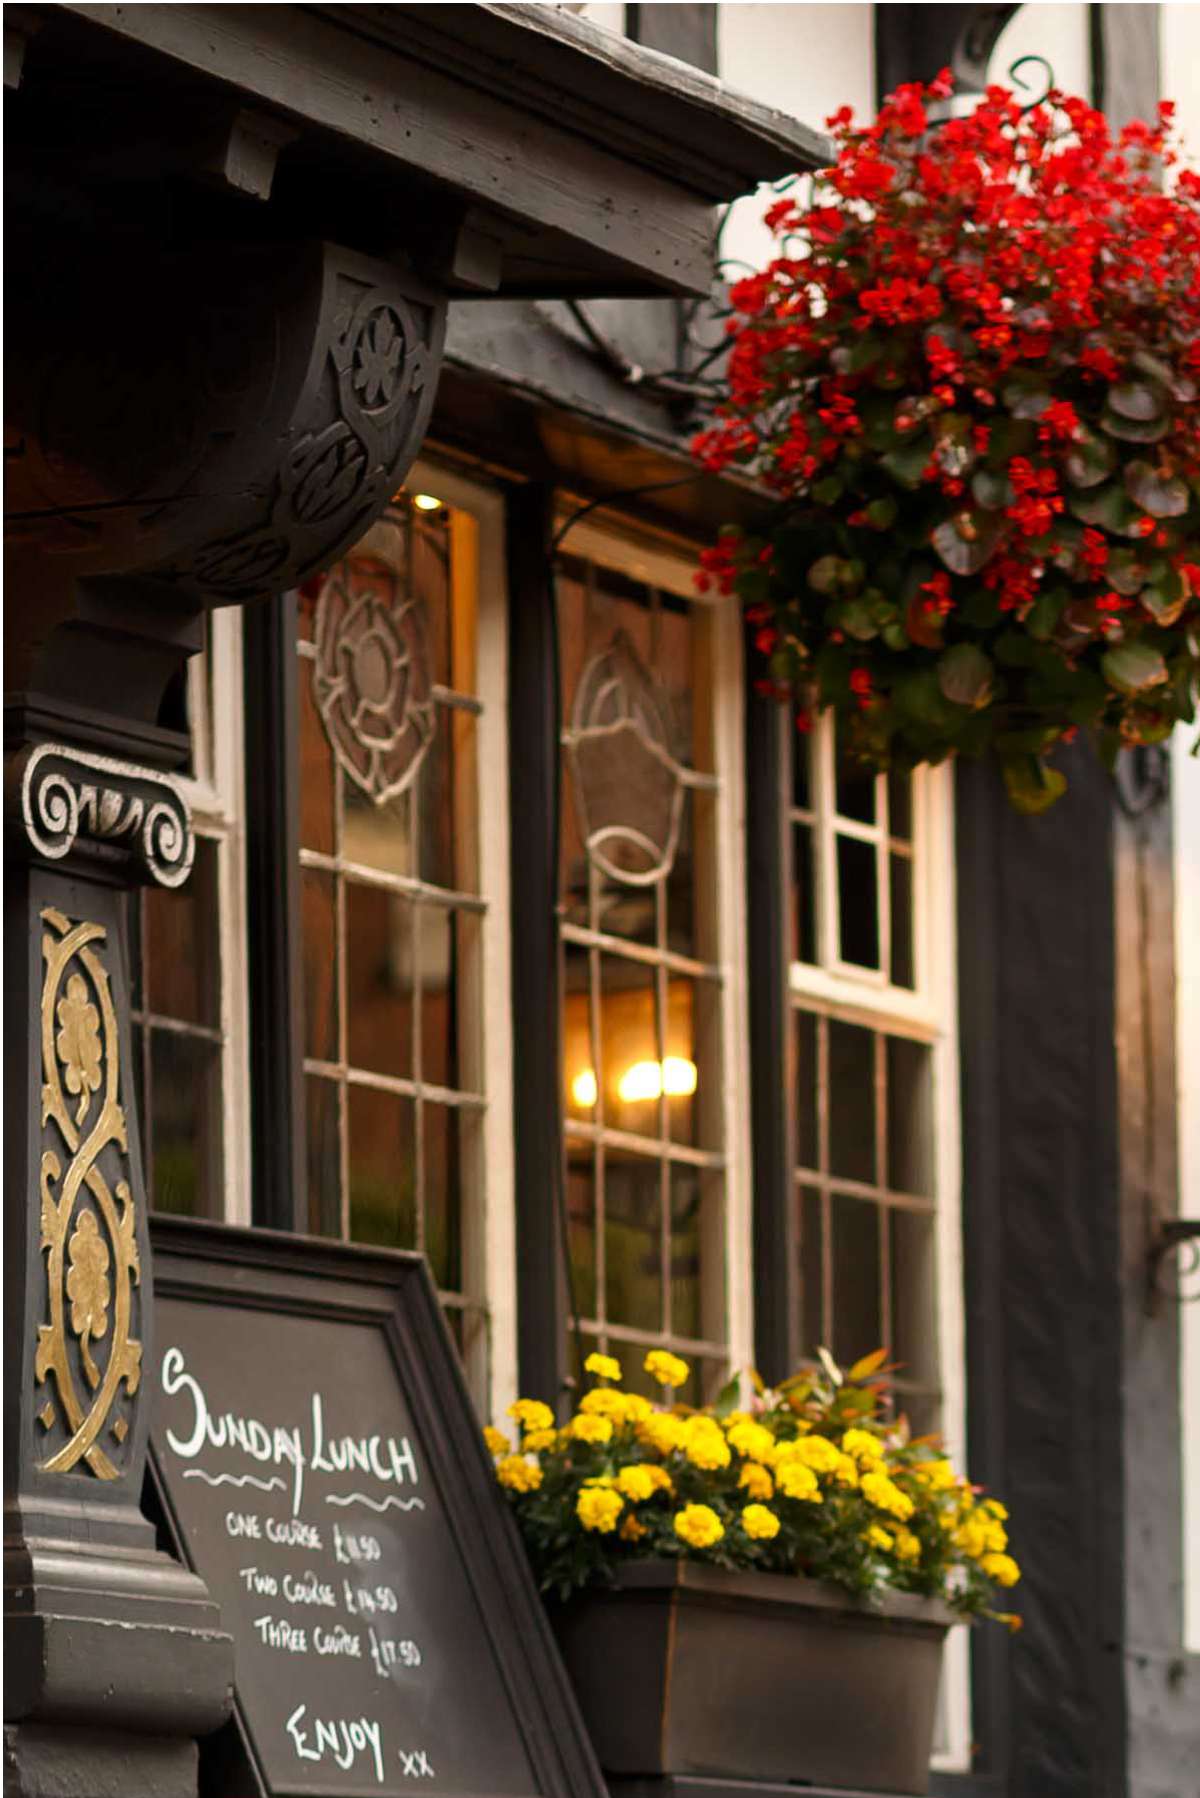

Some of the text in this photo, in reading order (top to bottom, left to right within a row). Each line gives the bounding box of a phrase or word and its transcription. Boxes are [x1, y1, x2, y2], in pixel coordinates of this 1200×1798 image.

[161, 1347, 418, 1516] SUNDAY LUNCH
[225, 1511, 262, 1539] ONE
[265, 1517, 323, 1550] COURSE
[239, 1567, 278, 1596] TWO
[282, 1569, 336, 1607] COURSE
[253, 1615, 308, 1652] THREE
[313, 1624, 361, 1658] COURSE
[286, 1704, 384, 1782] ENJOY
